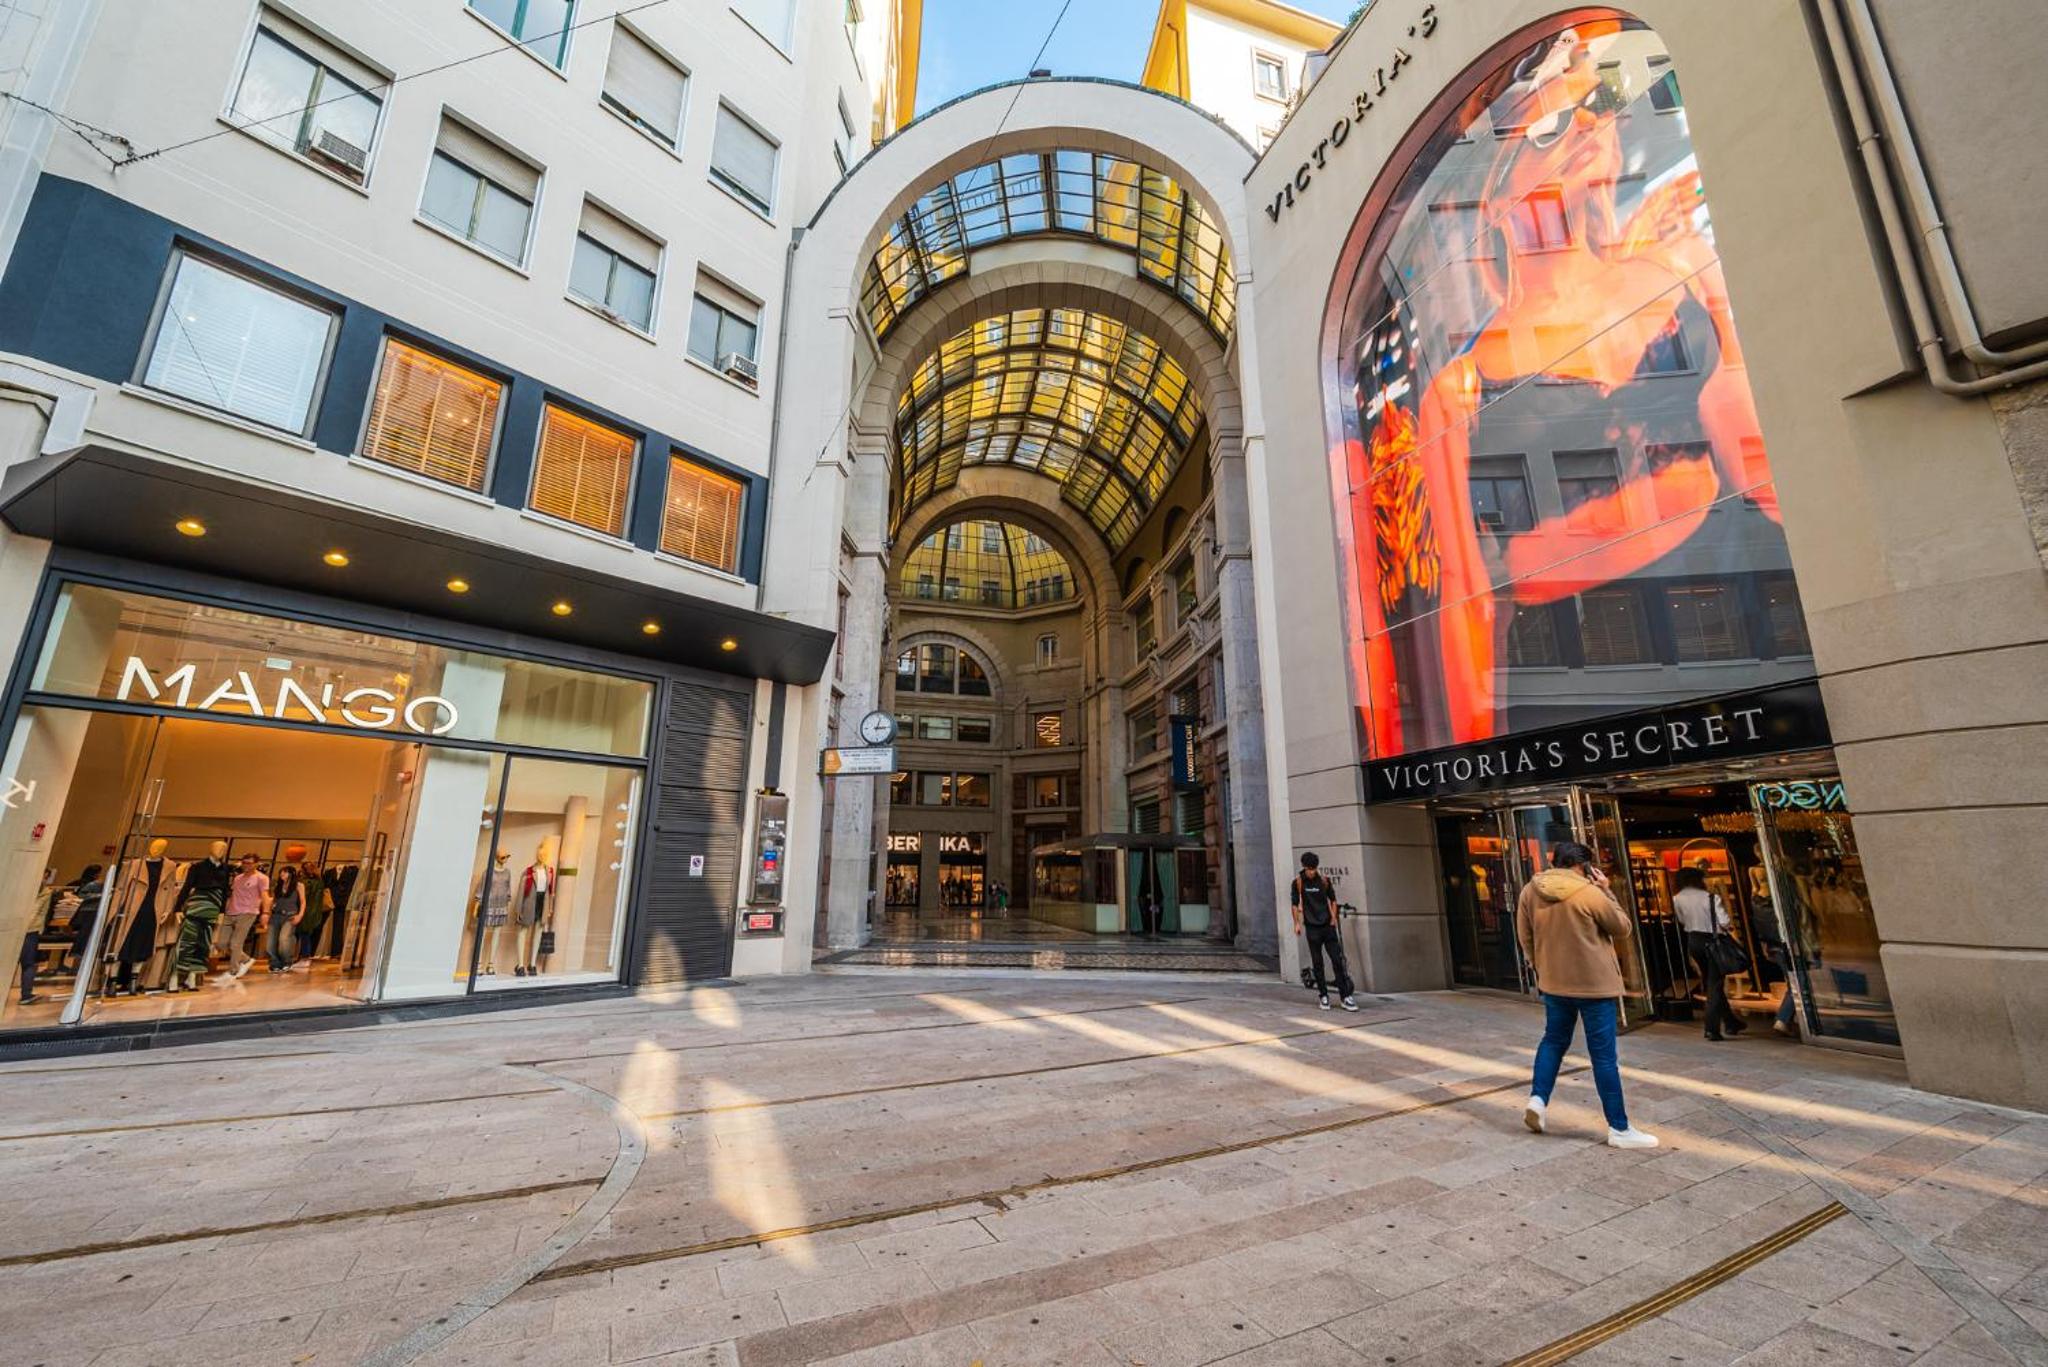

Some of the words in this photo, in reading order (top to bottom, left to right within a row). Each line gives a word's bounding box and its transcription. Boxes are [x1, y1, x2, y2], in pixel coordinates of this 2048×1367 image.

[1265, 4, 1438, 223] VICTORIA'S
[116, 656, 458, 734] MANGO
[1383, 742, 1564, 791] VICTORIA'S
[1583, 708, 1764, 763] SECRET
